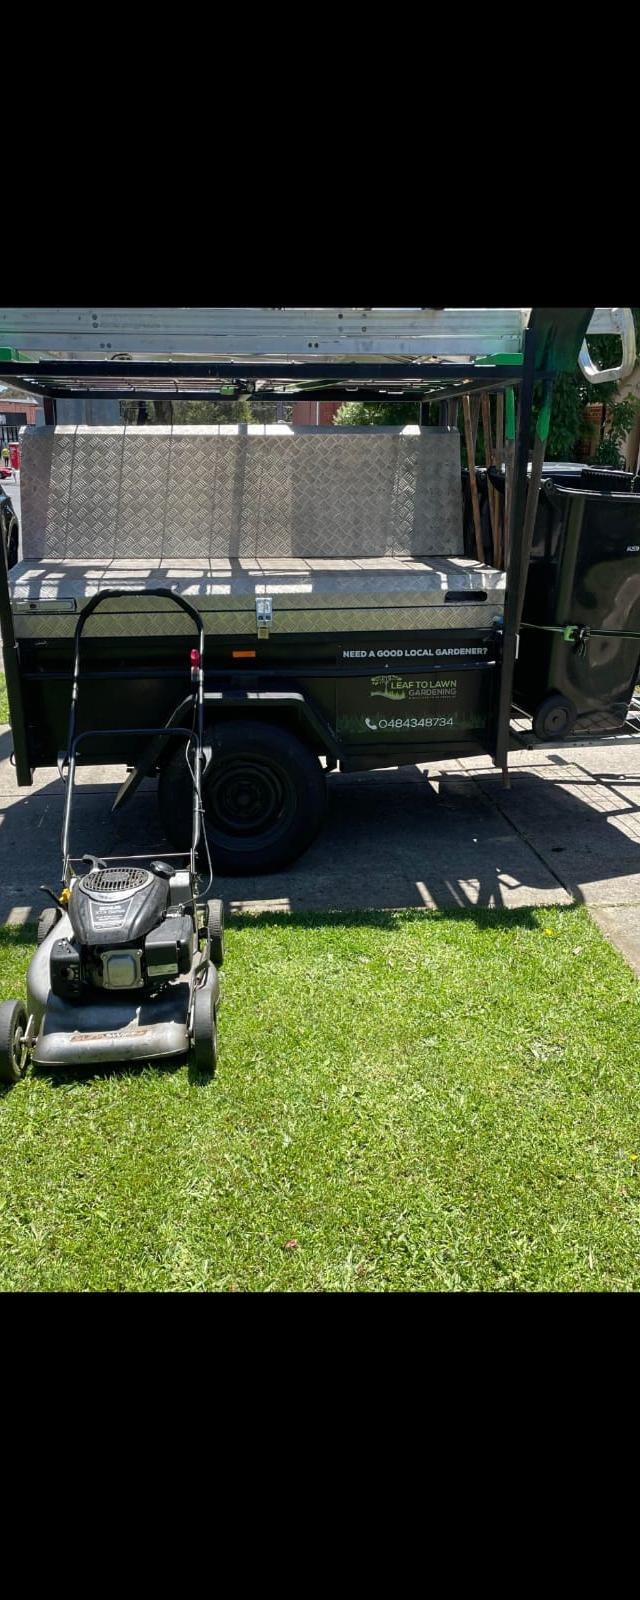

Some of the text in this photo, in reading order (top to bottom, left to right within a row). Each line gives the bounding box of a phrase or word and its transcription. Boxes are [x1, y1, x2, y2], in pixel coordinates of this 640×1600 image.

[368, 650, 376, 658] A
[377, 649, 403, 657] GOOD
[391, 680, 457, 689] LEAF TO LAWN
[408, 688, 456, 696] GARDENING
[378, 717, 453, 728] 0484348734
